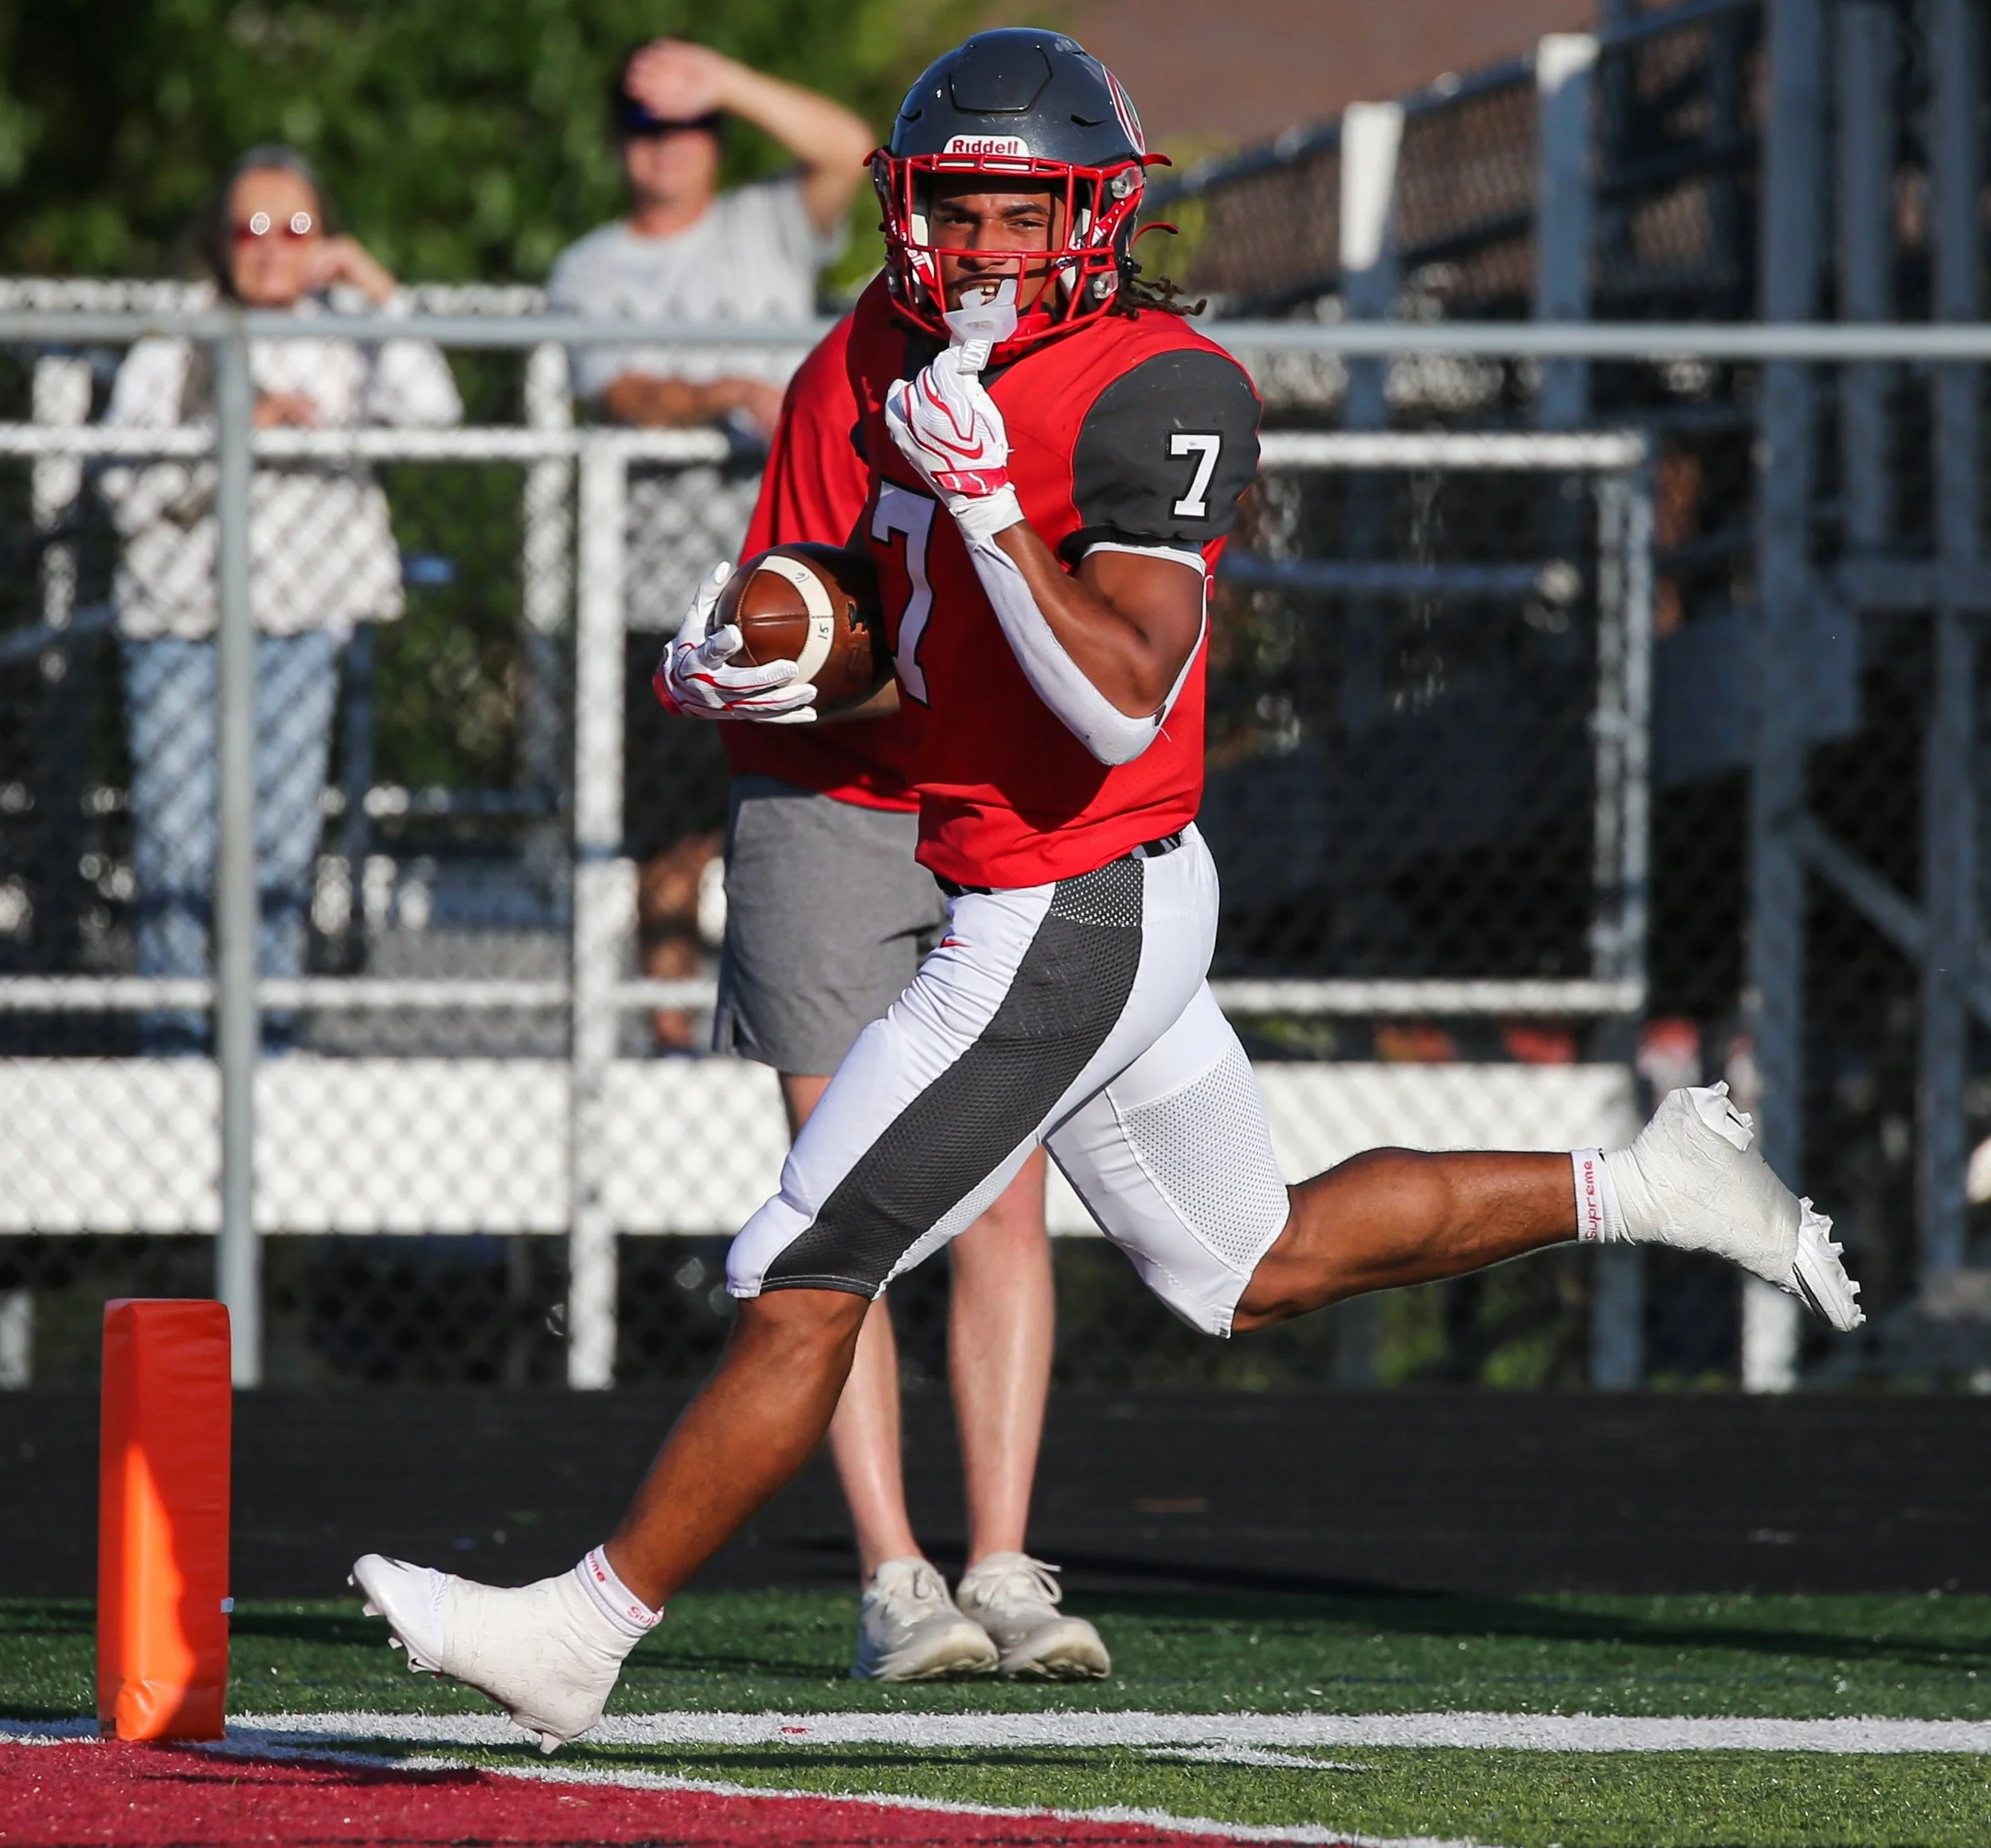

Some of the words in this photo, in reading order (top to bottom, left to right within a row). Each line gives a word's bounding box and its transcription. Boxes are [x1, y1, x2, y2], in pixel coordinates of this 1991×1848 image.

[952, 139, 1019, 155] Riddell
[1170, 434, 1220, 516] 7
[871, 480, 936, 704] 7
[817, 623, 829, 640] 15
[1584, 1161, 1602, 1239] Supreme
